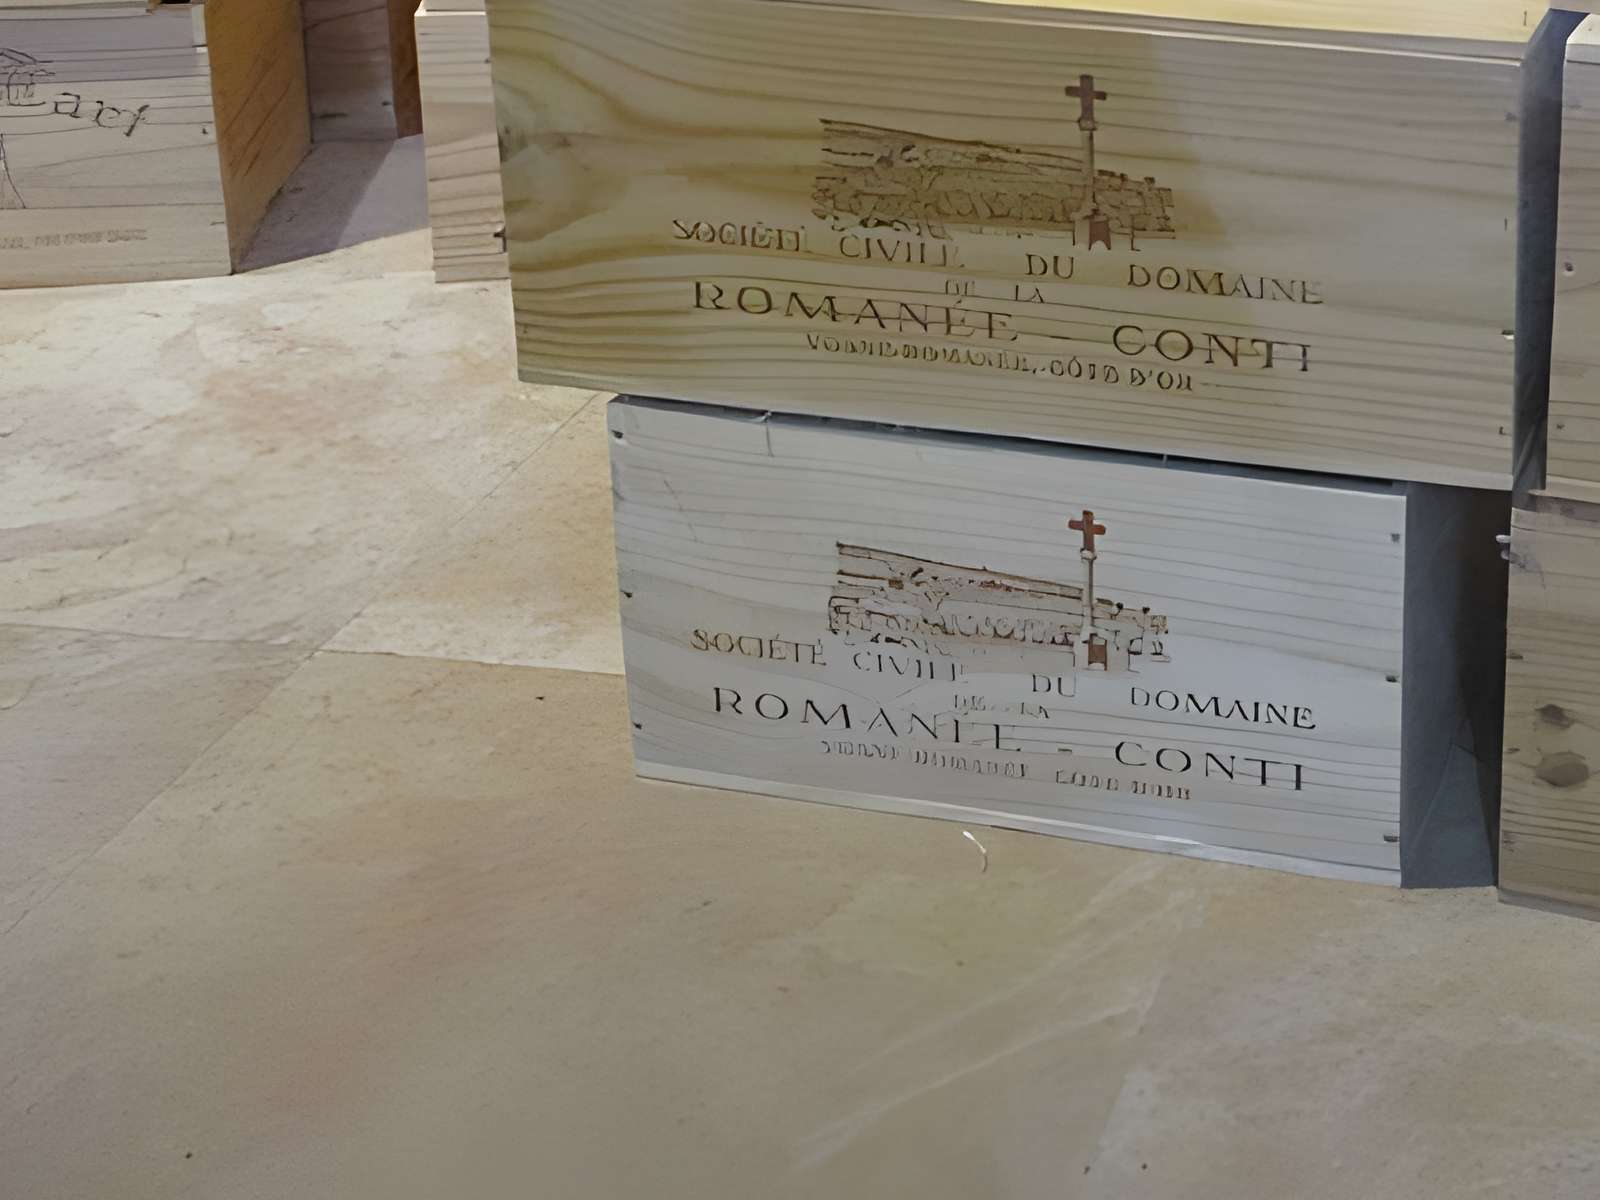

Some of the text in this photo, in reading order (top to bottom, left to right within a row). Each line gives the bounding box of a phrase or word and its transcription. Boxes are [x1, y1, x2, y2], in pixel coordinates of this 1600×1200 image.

[1024, 252, 1076, 280] DU
[1127, 263, 1324, 306] DOMAINE
[1111, 324, 1313, 373] CONTI
[1031, 673, 1078, 699] DU
[1130, 686, 1318, 731] DOMAINE
[1113, 741, 1304, 792] CONTI
